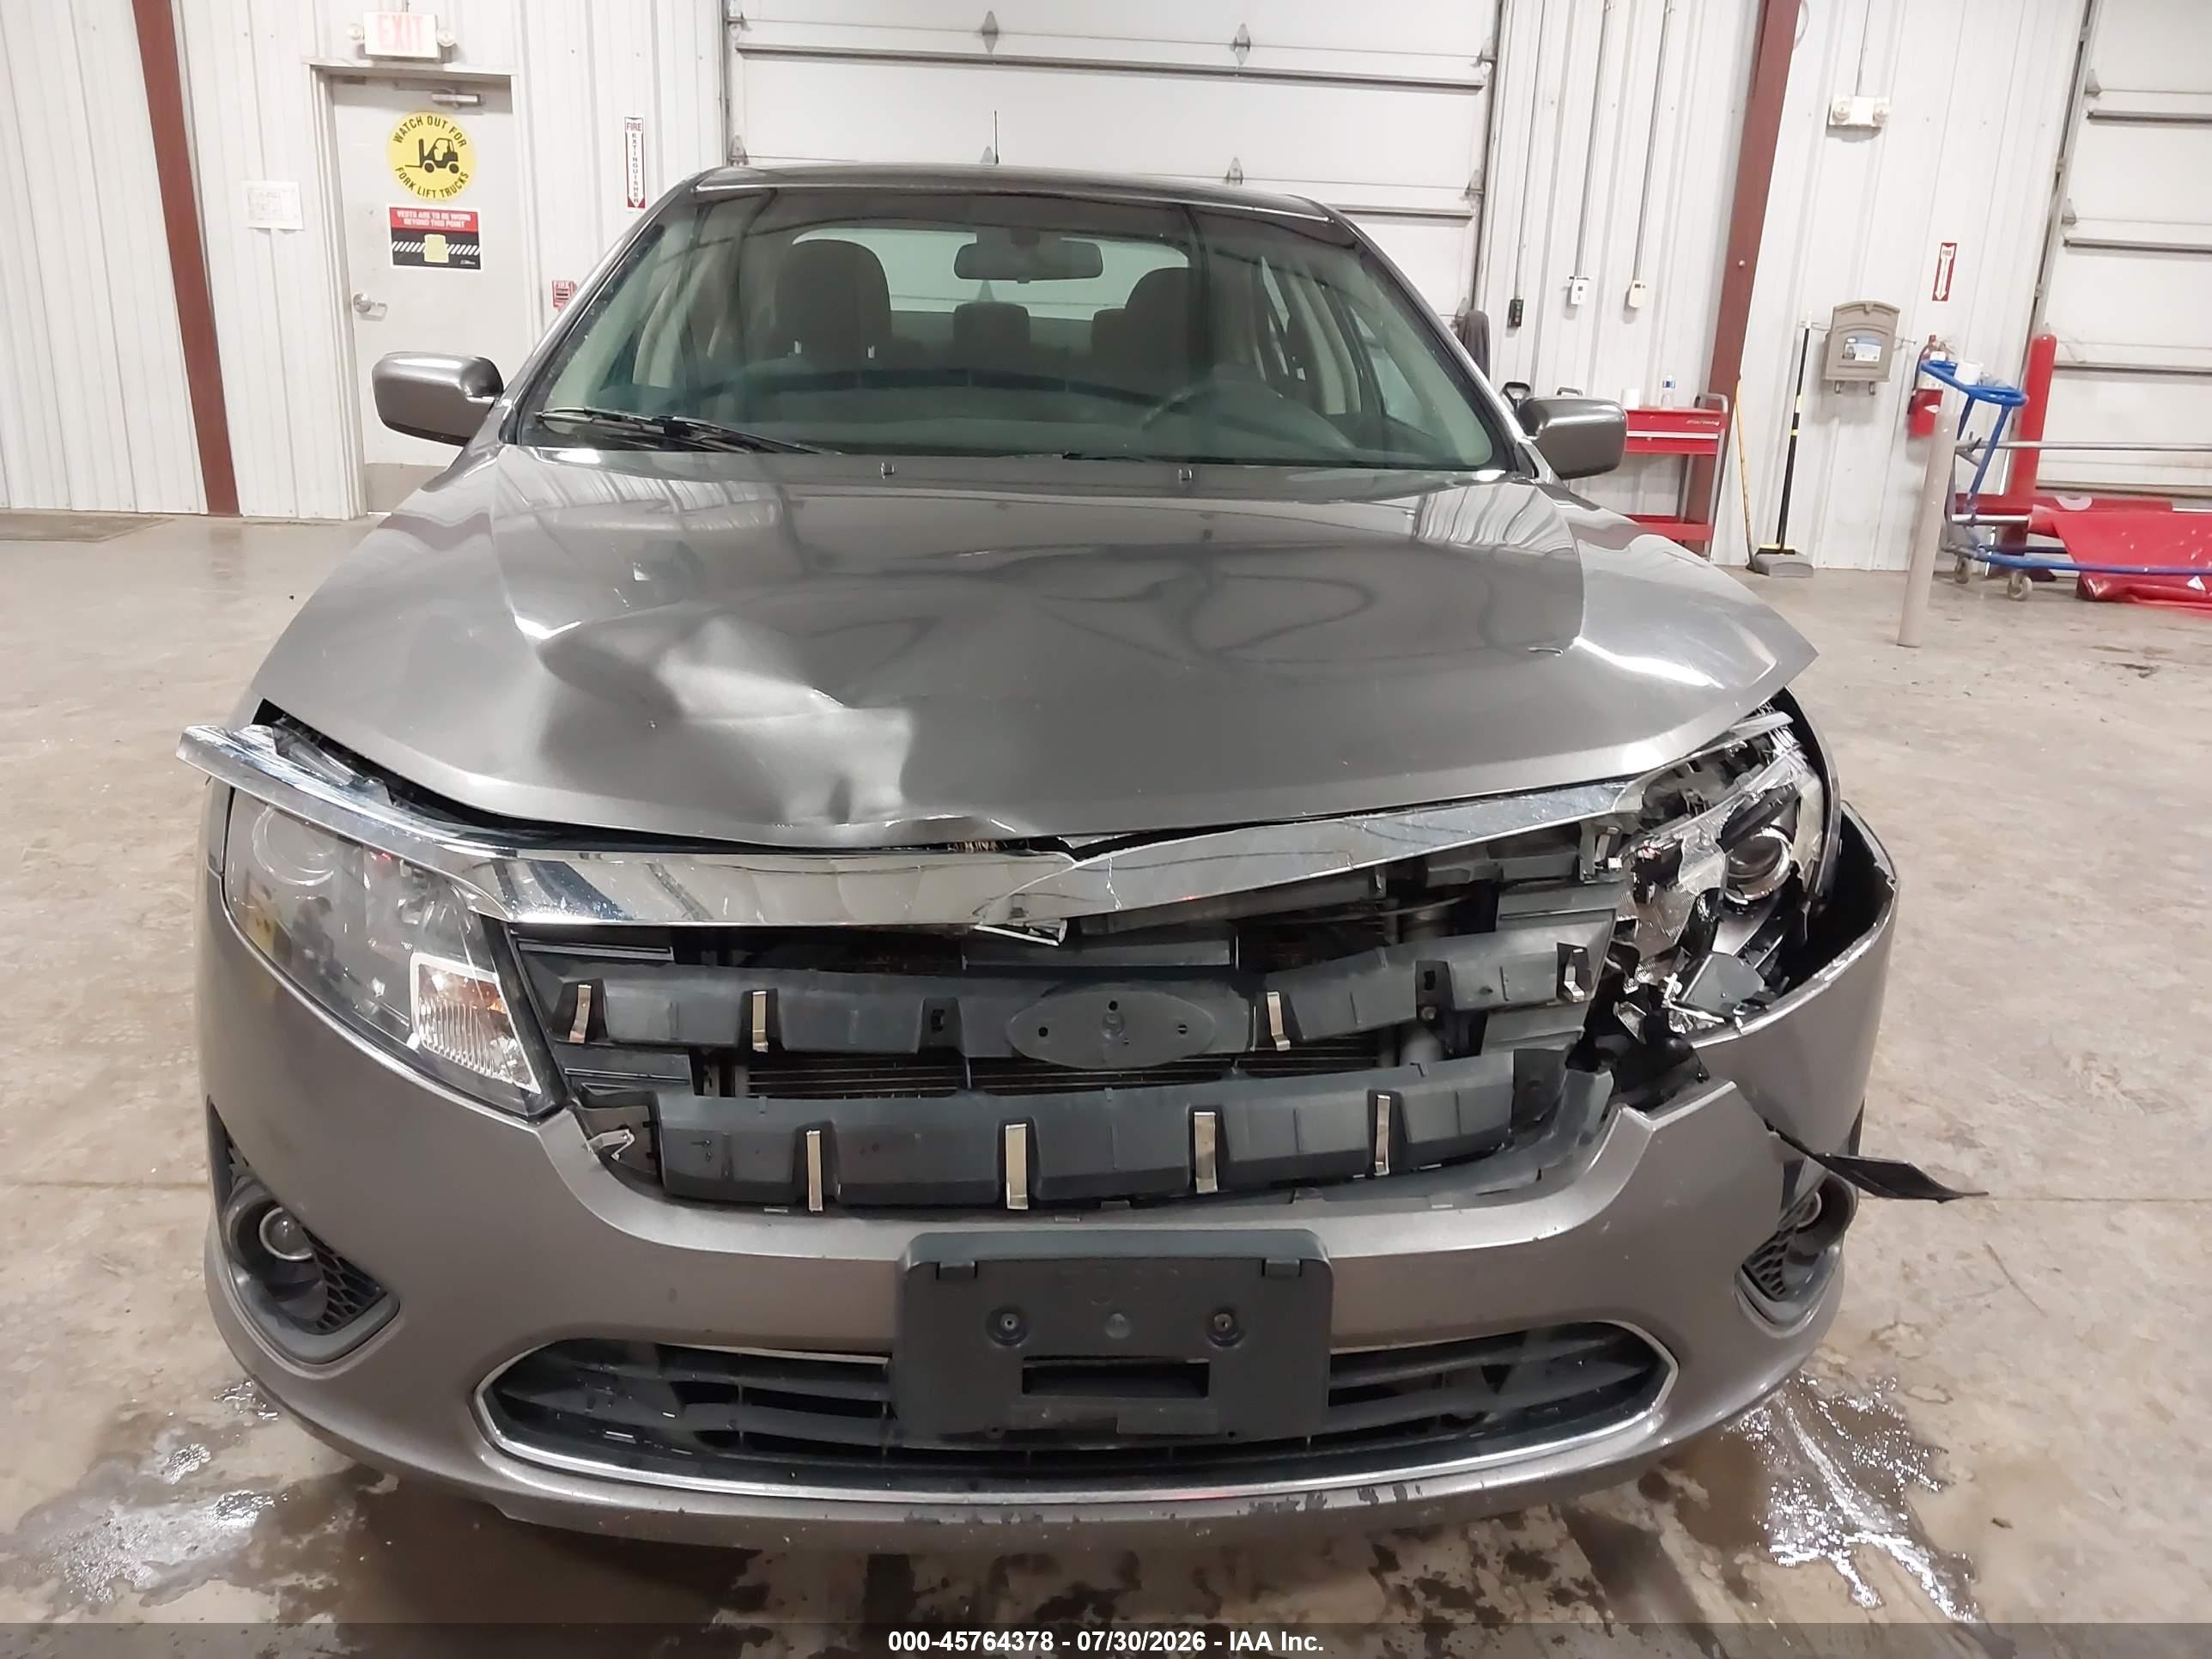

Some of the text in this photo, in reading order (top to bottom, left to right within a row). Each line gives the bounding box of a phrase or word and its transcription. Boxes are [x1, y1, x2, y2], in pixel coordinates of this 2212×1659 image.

[377, 14, 423, 52] EXIT
[392, 115, 467, 148] WATCH OUT FOR
[626, 122, 642, 131] FIRE
[395, 167, 469, 198] FORK LIFT TRUCKS
